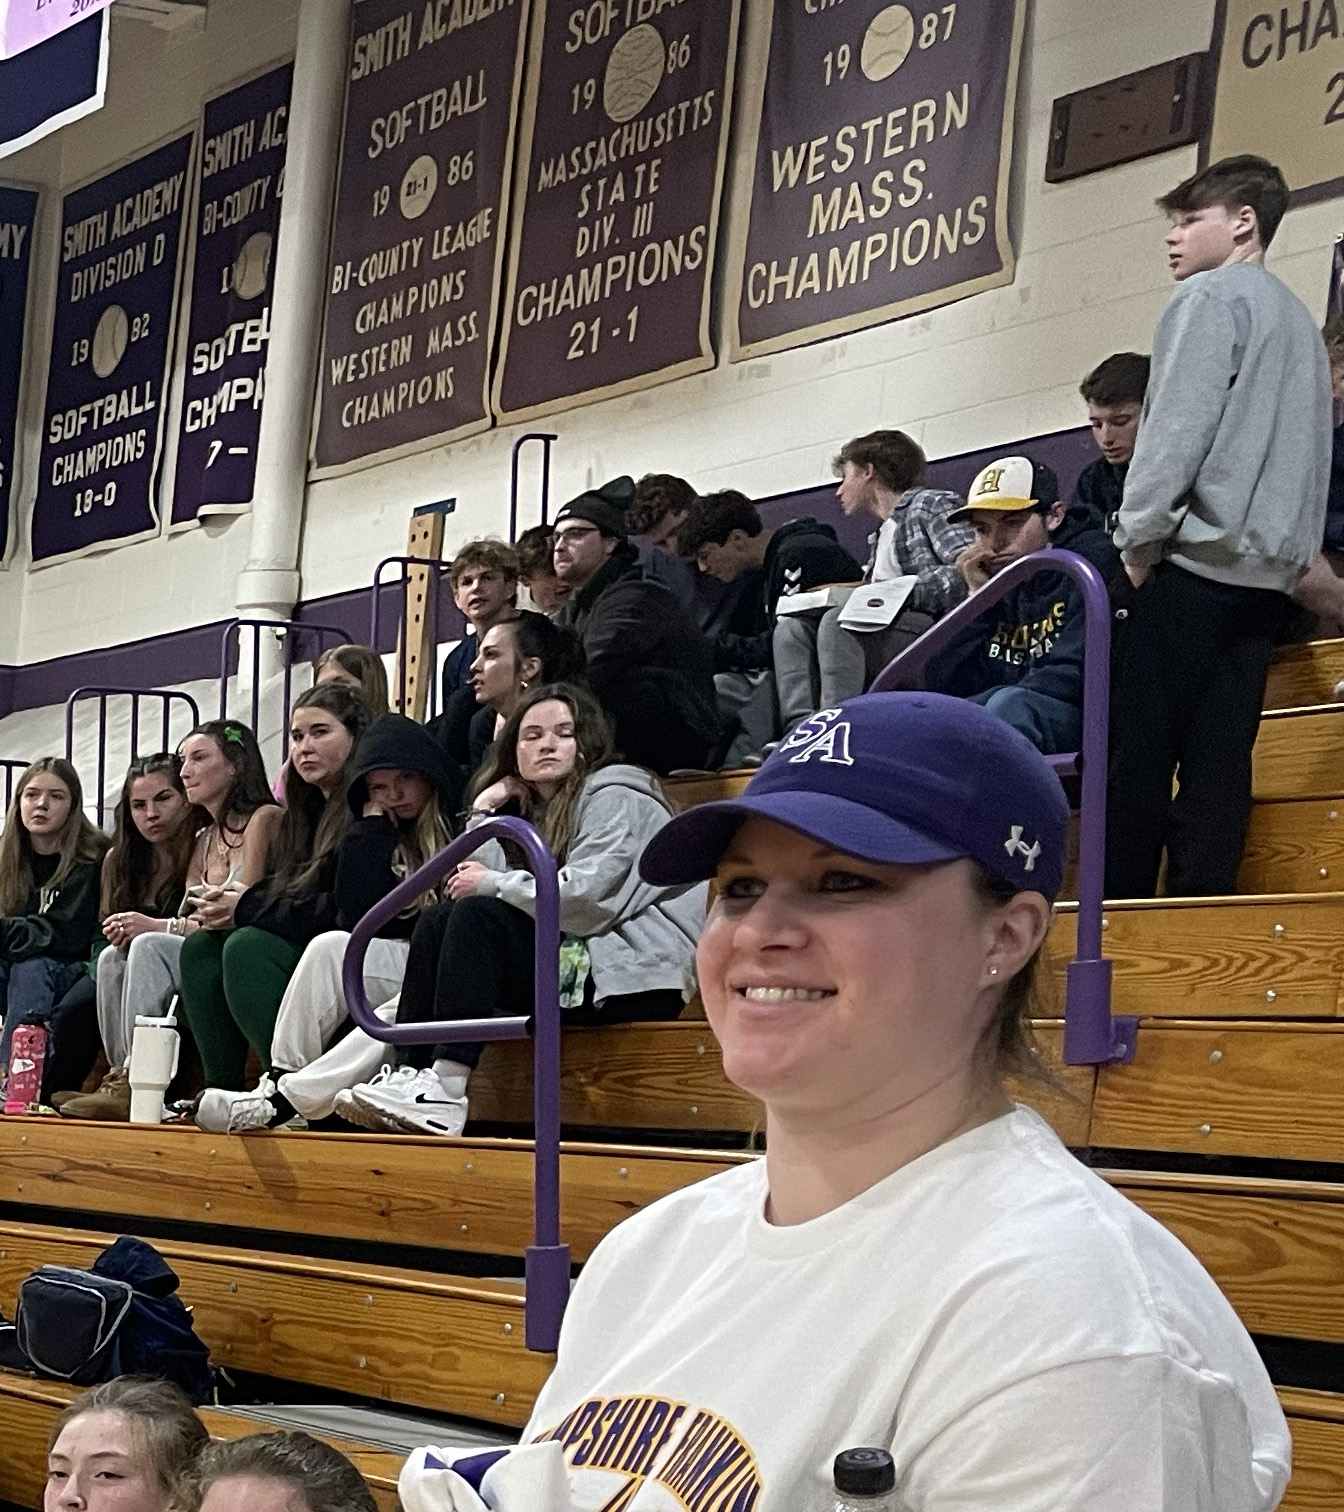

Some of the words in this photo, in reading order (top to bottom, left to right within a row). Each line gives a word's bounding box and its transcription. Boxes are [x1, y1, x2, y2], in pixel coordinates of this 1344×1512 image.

[823, 43, 851, 87] 19
[918, 4, 958, 51] 87
[367, 70, 488, 159] SOFTBALL
[538, 89, 716, 193] MASSACHUSETTS
[771, 83, 969, 194] WESTERN
[64, 206, 107, 262] SMITH
[111, 171, 185, 243] ACADEMY
[577, 158, 662, 220] STATE
[808, 159, 933, 238] MASS.
[331, 234, 423, 295] BI-COUNTY
[431, 207, 492, 261] LEAGUE
[576, 213, 620, 259] DIV.
[631, 201, 653, 240] III
[749, 195, 987, 311] CHAMPIONS
[71, 247, 143, 303] DIVISION
[355, 270, 466, 334] CHAMPIONS
[517, 225, 706, 327] CHAMPIONS
[331, 334, 413, 387] WESTERN
[49, 380, 157, 445] SOFTBALL
[341, 366, 454, 429] CHAMPIONS
[52, 429, 146, 487] CHAMPIONS
[977, 468, 1005, 495] H
[74, 482, 117, 518] 18-0
[781, 708, 855, 766] SA
